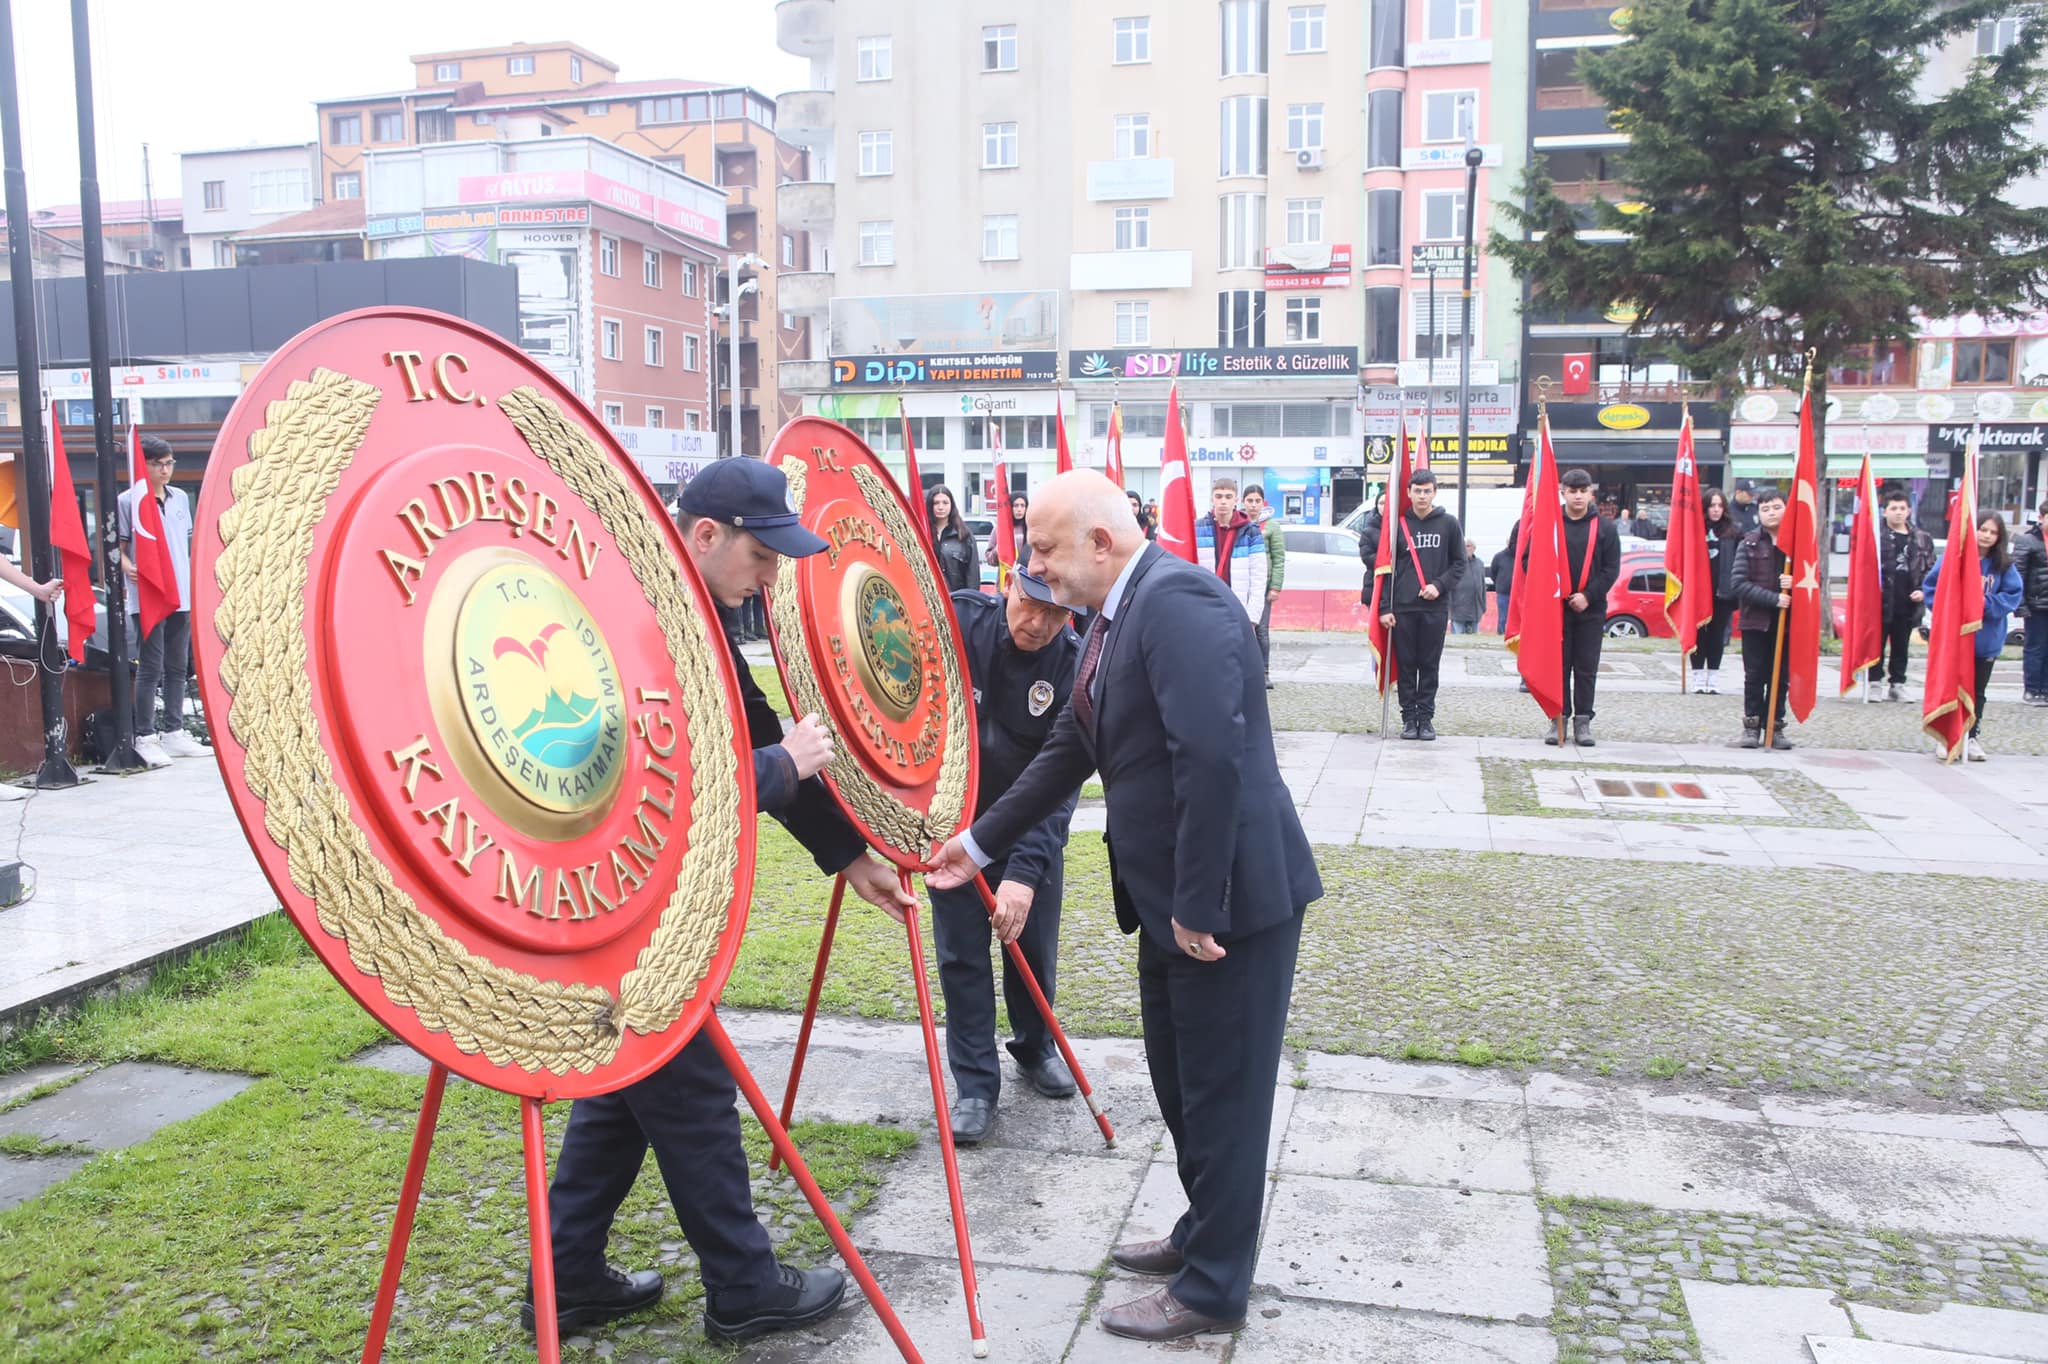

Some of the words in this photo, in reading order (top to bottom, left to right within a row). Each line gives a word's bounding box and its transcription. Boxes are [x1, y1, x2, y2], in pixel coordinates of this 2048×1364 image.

[501, 177, 554, 196] ALTUS
[501, 208, 587, 223] ANKASTRE
[524, 234, 573, 242] HOOVER
[930, 357, 972, 367] KENTSEL
[974, 354, 1022, 367] DÖNÜŞÜM
[1134, 353, 1172, 375] SD
[1186, 352, 1218, 376] life
[1223, 354, 1272, 371] Estetik
[1276, 355, 1287, 370] &
[1292, 354, 1350, 370] Güzellik
[384, 350, 488, 407] T.C.
[929, 368, 960, 381] YAPI
[1444, 390, 1498, 403] Siorta
[974, 398, 1016, 410] Garanti
[1939, 427, 1953, 441] By
[1448, 440, 1507, 451] MNDIRA
[377, 471, 602, 606] ARDEŞEN
[497, 578, 537, 603] T.C.
[385, 687, 679, 921] KAYMAKAMLIĞI
